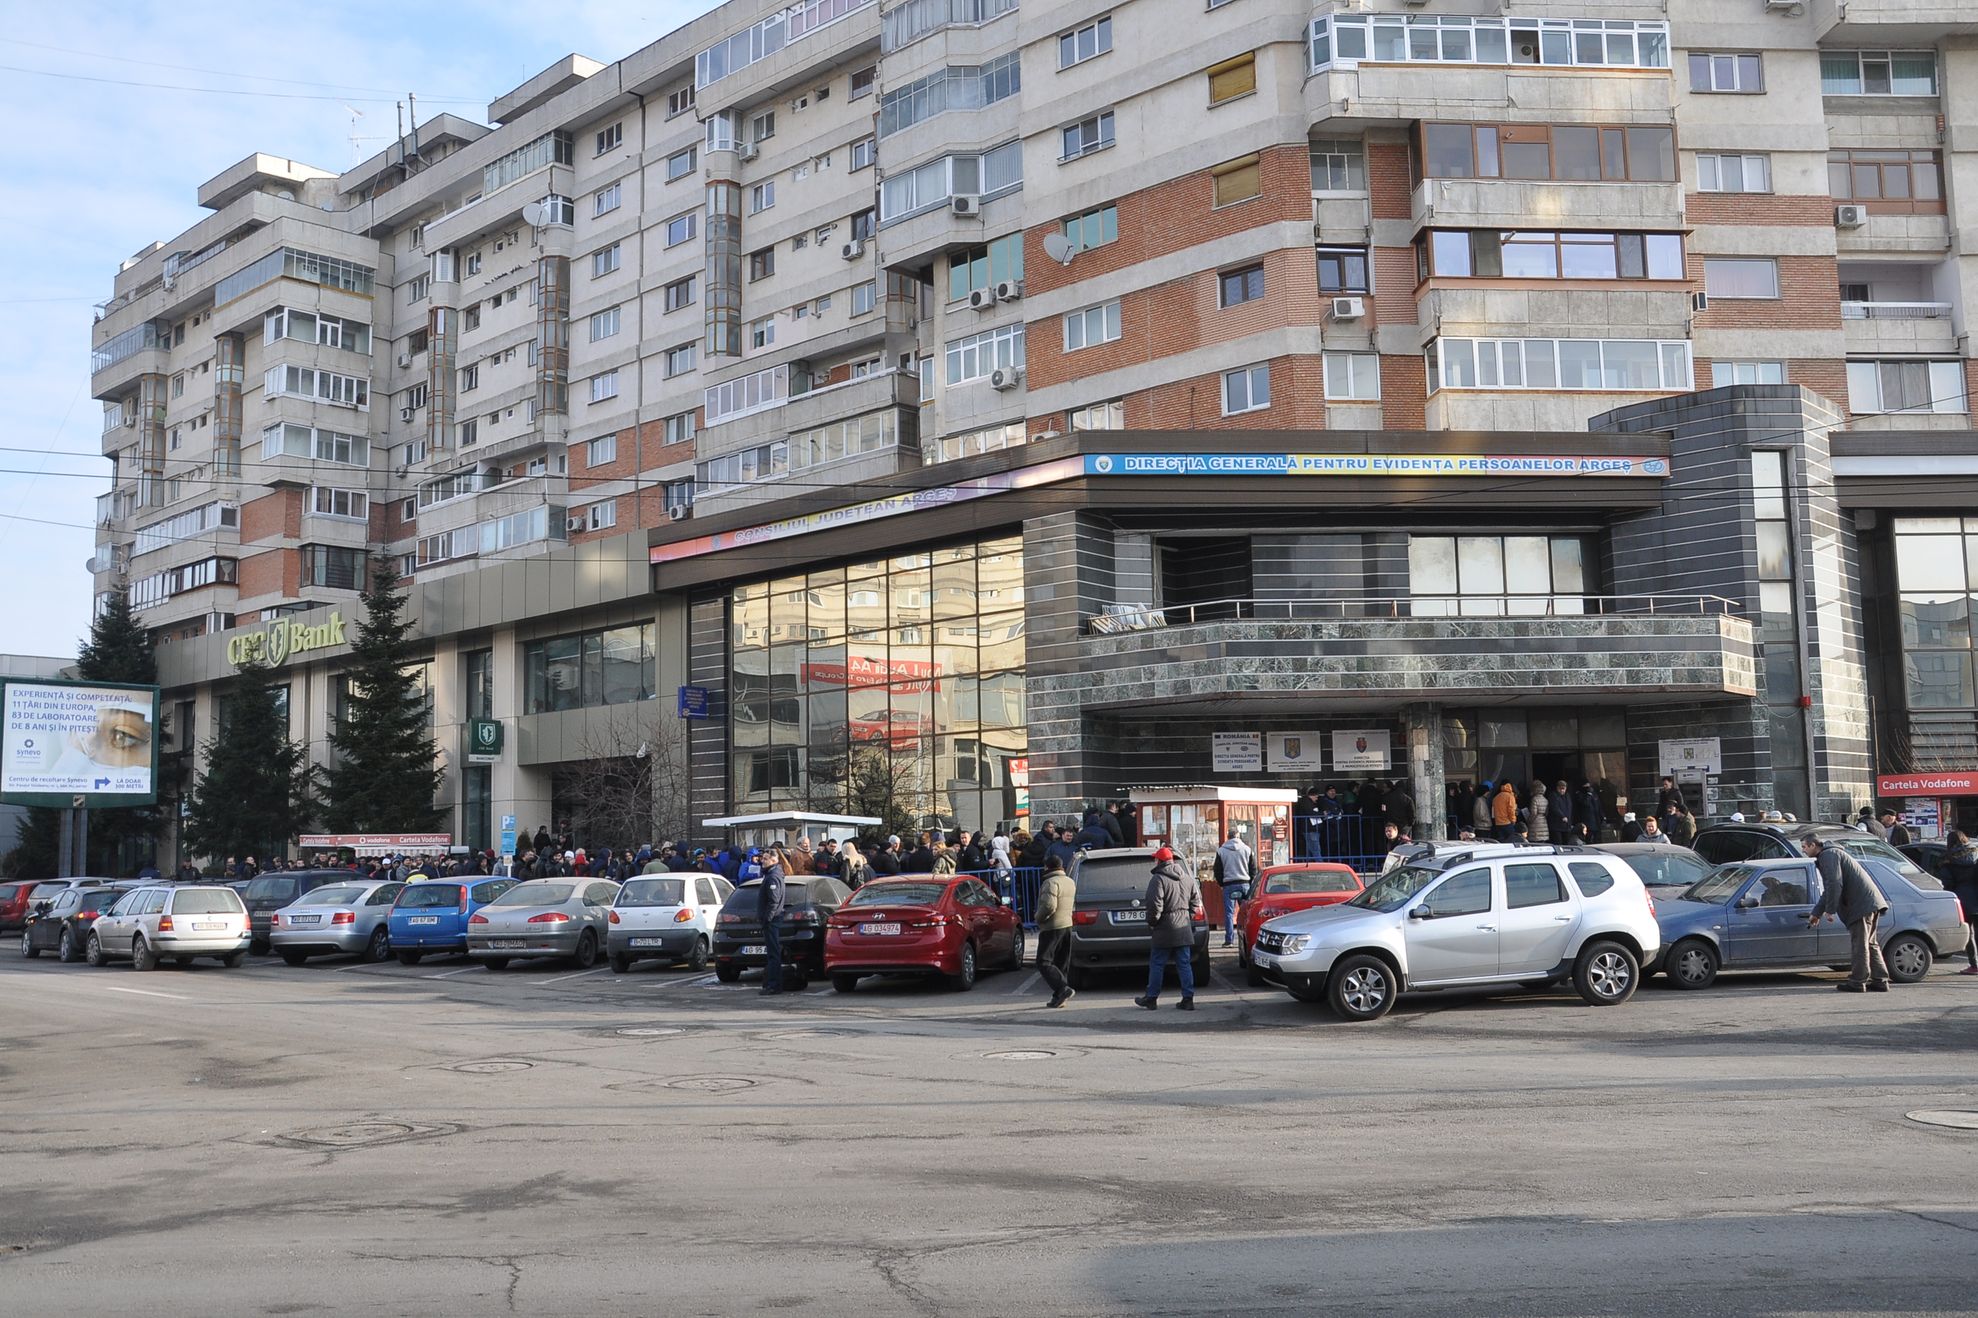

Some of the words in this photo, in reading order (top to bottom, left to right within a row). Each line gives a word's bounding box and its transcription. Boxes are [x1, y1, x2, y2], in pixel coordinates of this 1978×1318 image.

[1208, 455, 1298, 470] GENERALĂ
[1302, 457, 1368, 470] PENTRU
[1458, 458, 1575, 472] PERSOANELOR
[735, 518, 809, 541] CONSILIUL
[289, 610, 347, 654] Bank
[60, 703, 97, 713] EUROPA,
[11, 722, 23, 730] DE
[24, 722, 30, 730] 8
[32, 723, 47, 731] ANI
[16, 749, 41, 757] synevo
[1882, 780, 1919, 790] Cartela
[1920, 778, 1971, 788] Vodafone
[399, 835, 420, 843] Cartela
[421, 835, 448, 843] Vodafone
[1120, 911, 1126, 920] B
[1128, 911, 1137, 919] 78
[863, 923, 873, 932] AG
[874, 923, 900, 932] 034974
